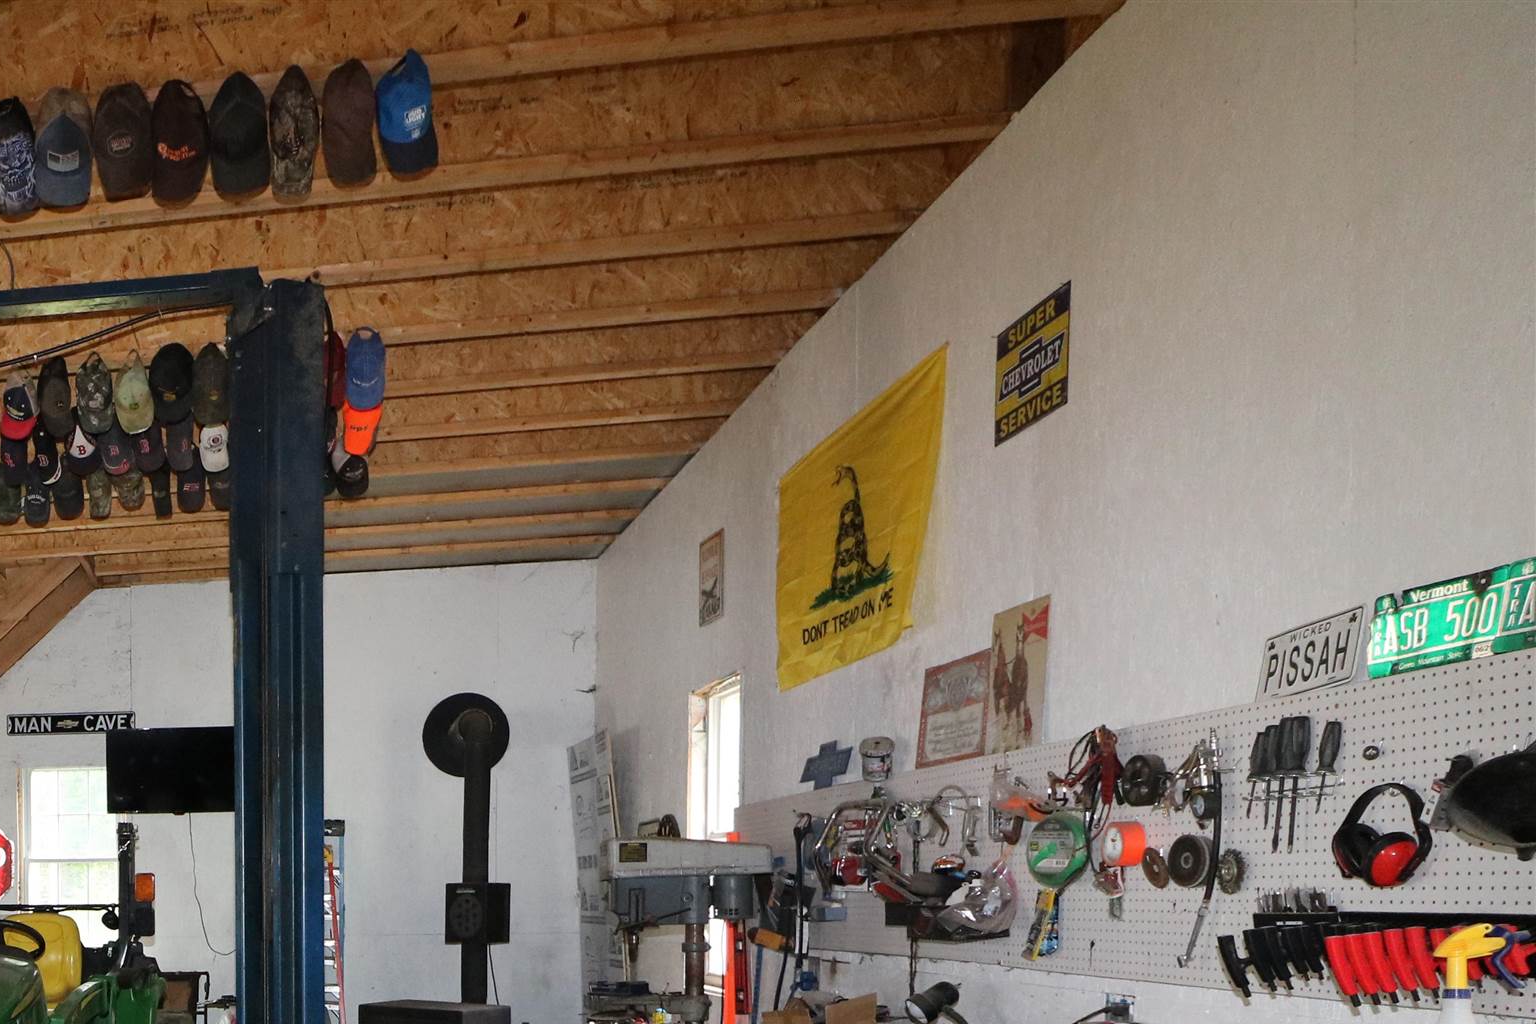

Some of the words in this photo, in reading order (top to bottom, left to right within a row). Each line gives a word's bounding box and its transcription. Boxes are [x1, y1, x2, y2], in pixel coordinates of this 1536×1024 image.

[1007, 298, 1056, 349] SUPER
[1001, 339, 1062, 395] CHEVROLET
[999, 383, 1063, 438] SERVICE
[76, 445, 87, 455] B
[1410, 578, 1469, 602] Vermont
[802, 620, 830, 646] DONT
[861, 599, 875, 620] ON
[1290, 621, 1332, 643] WICKED
[1383, 607, 1429, 655] ASB
[1444, 592, 1498, 642] 500
[1264, 628, 1351, 693] PISSAH
[14, 716, 52, 733] MAN
[83, 714, 128, 731] CAVE
